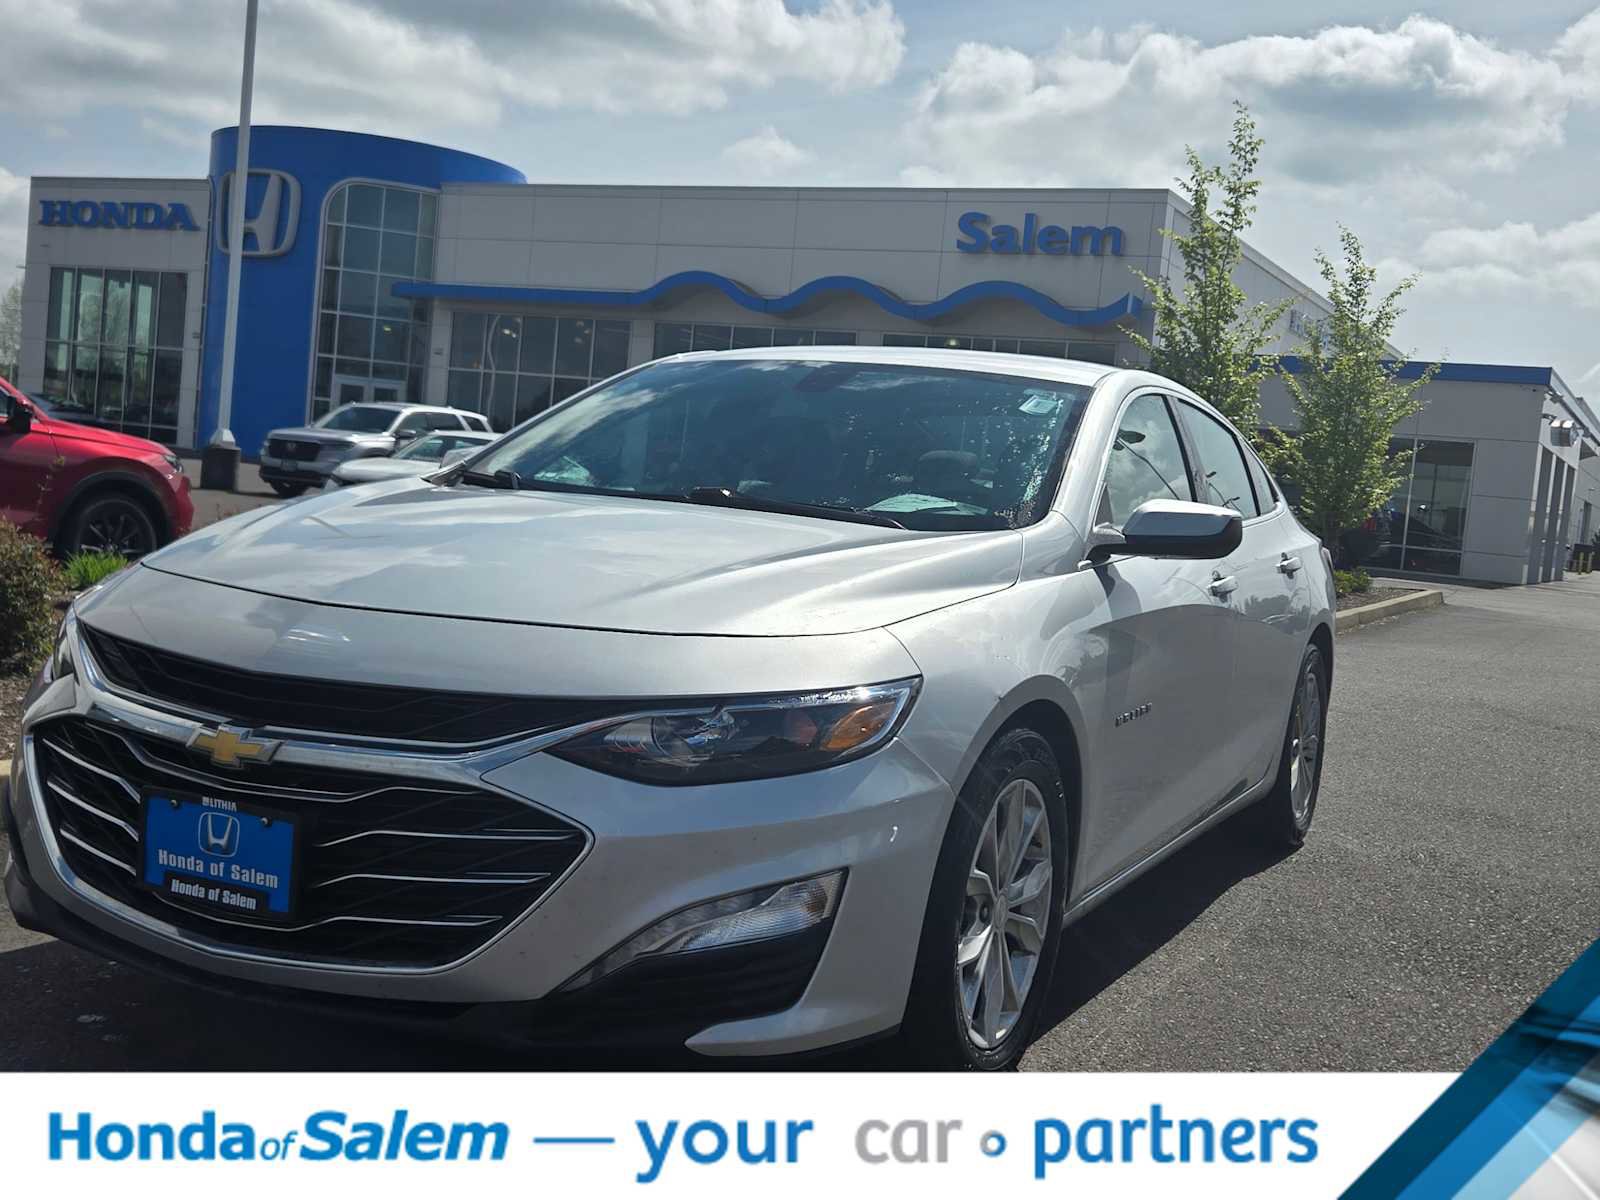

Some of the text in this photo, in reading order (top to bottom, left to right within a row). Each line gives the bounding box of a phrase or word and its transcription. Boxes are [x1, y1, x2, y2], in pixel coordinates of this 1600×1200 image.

[38, 199, 200, 232] HONDA
[956, 211, 1123, 256] Salem
[210, 797, 237, 812] LITHIA
[158, 848, 279, 889] Honda of Salem
[170, 878, 257, 910] Honda of Salem
